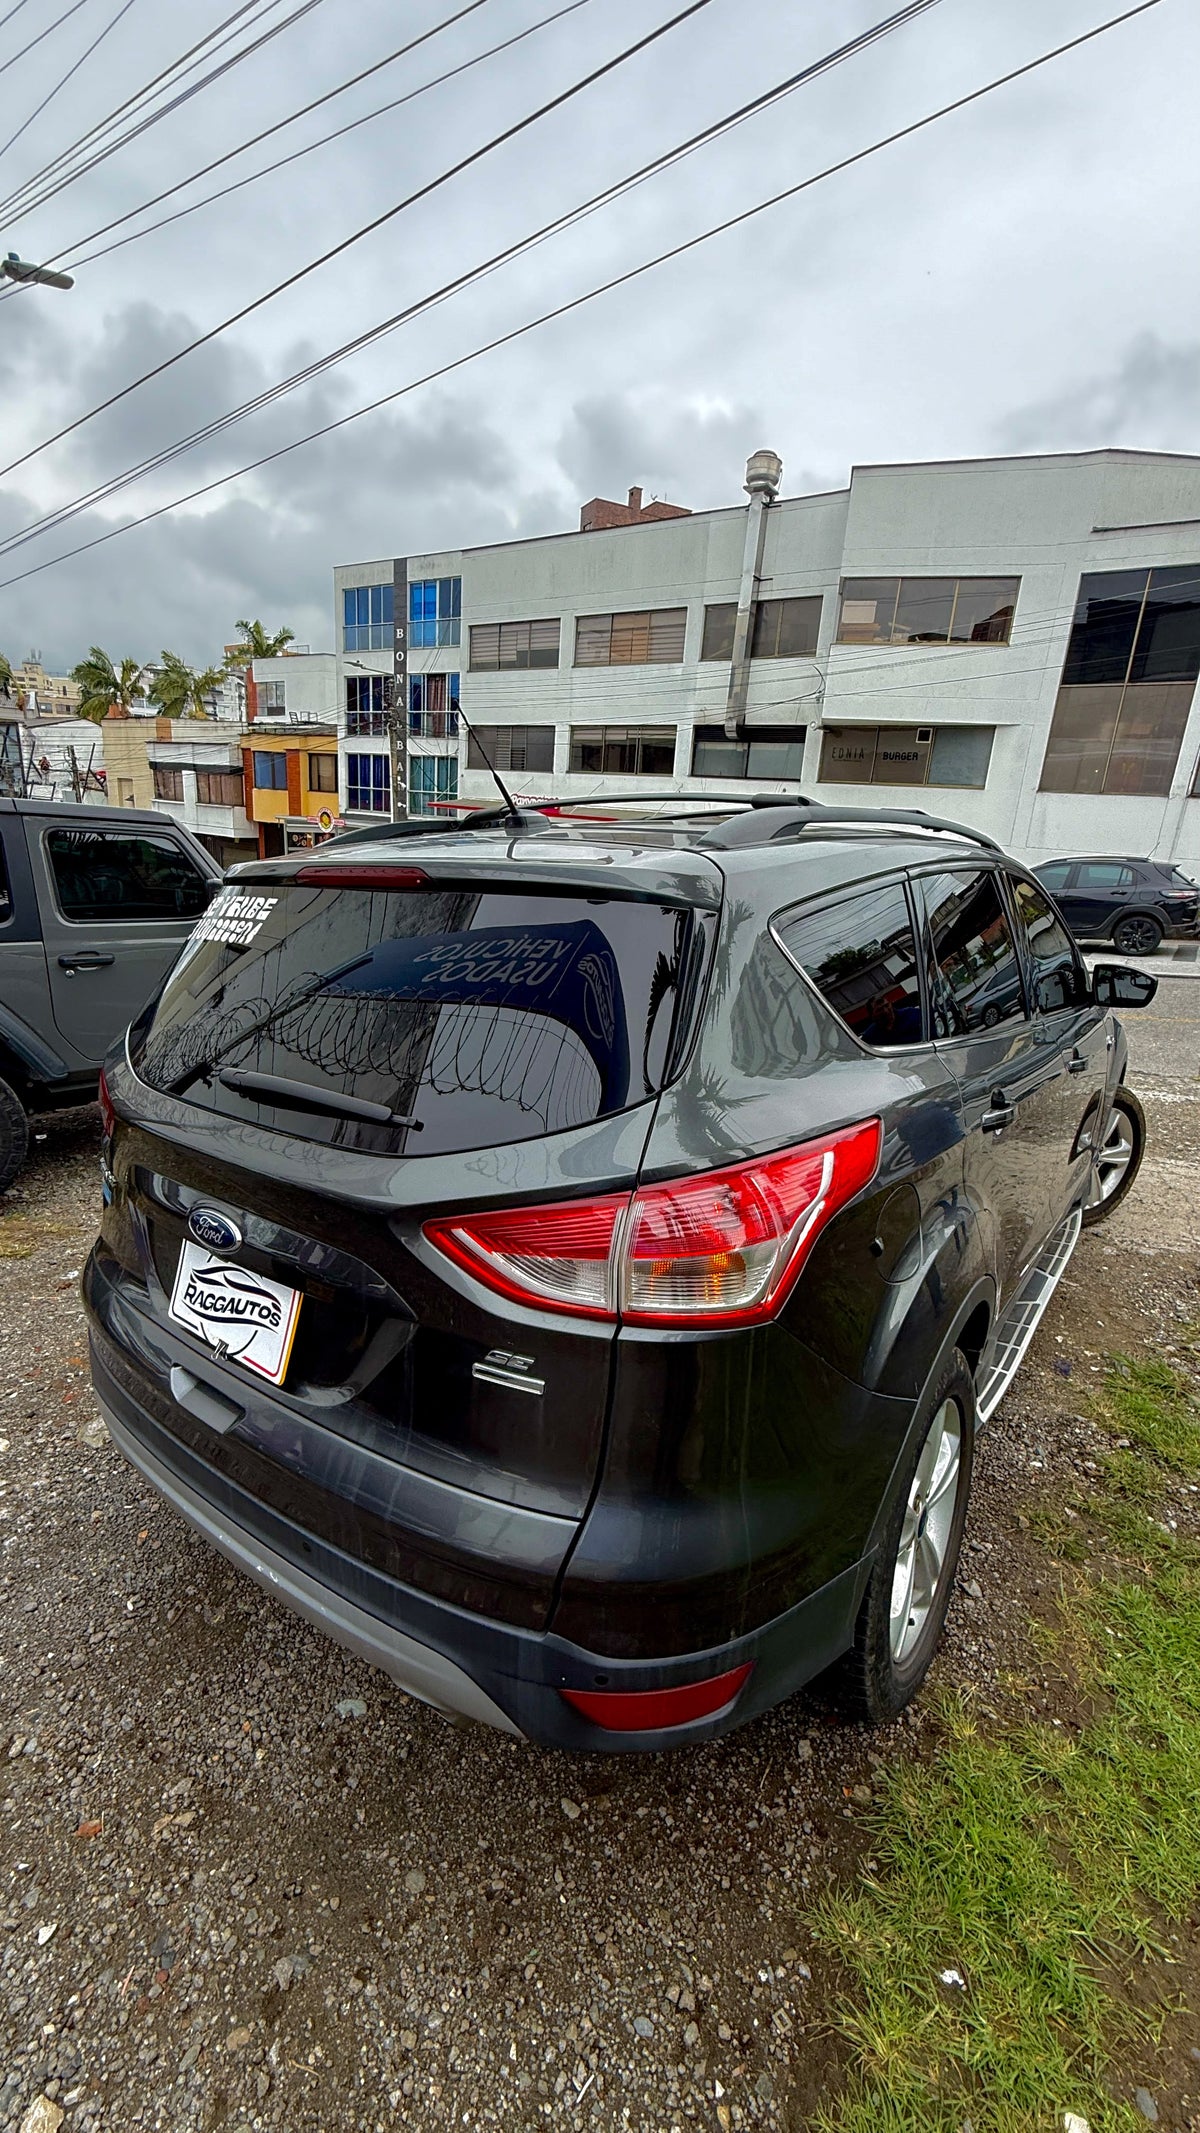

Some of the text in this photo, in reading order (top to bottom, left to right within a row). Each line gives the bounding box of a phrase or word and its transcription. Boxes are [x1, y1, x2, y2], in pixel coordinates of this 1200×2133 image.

[882, 752, 918, 760] BURGER
[196, 1216, 225, 1245] Ford
[184, 1283, 282, 1327] RAGGAUTOS
[485, 1350, 535, 1370] SE
